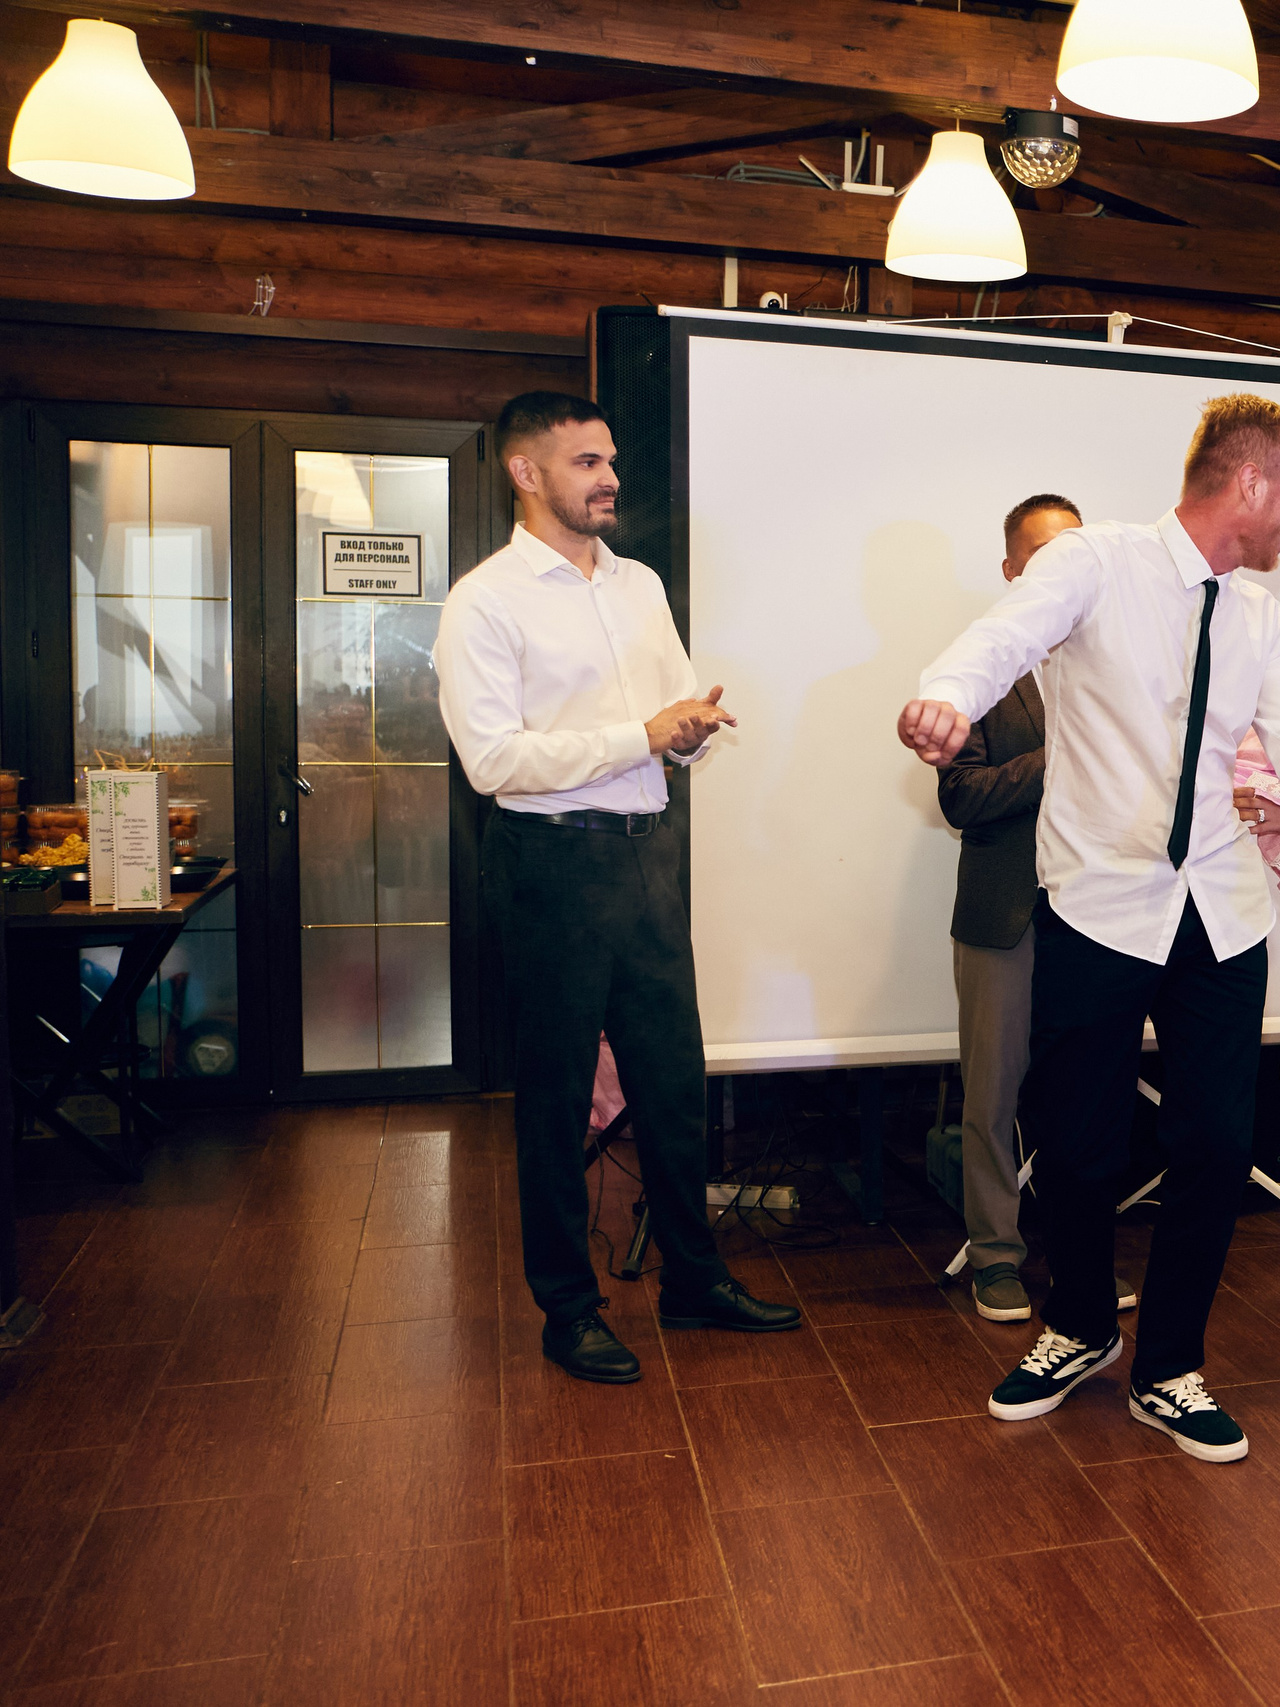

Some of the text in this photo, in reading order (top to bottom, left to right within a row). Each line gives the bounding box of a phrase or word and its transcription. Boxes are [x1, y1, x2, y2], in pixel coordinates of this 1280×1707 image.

[340, 540, 404, 551] ВХОД ТОЛЬКО
[334, 553, 410, 564] ДЛЯ ПЕРСОНАЛА
[348, 579, 397, 589] STAFF ONLY
